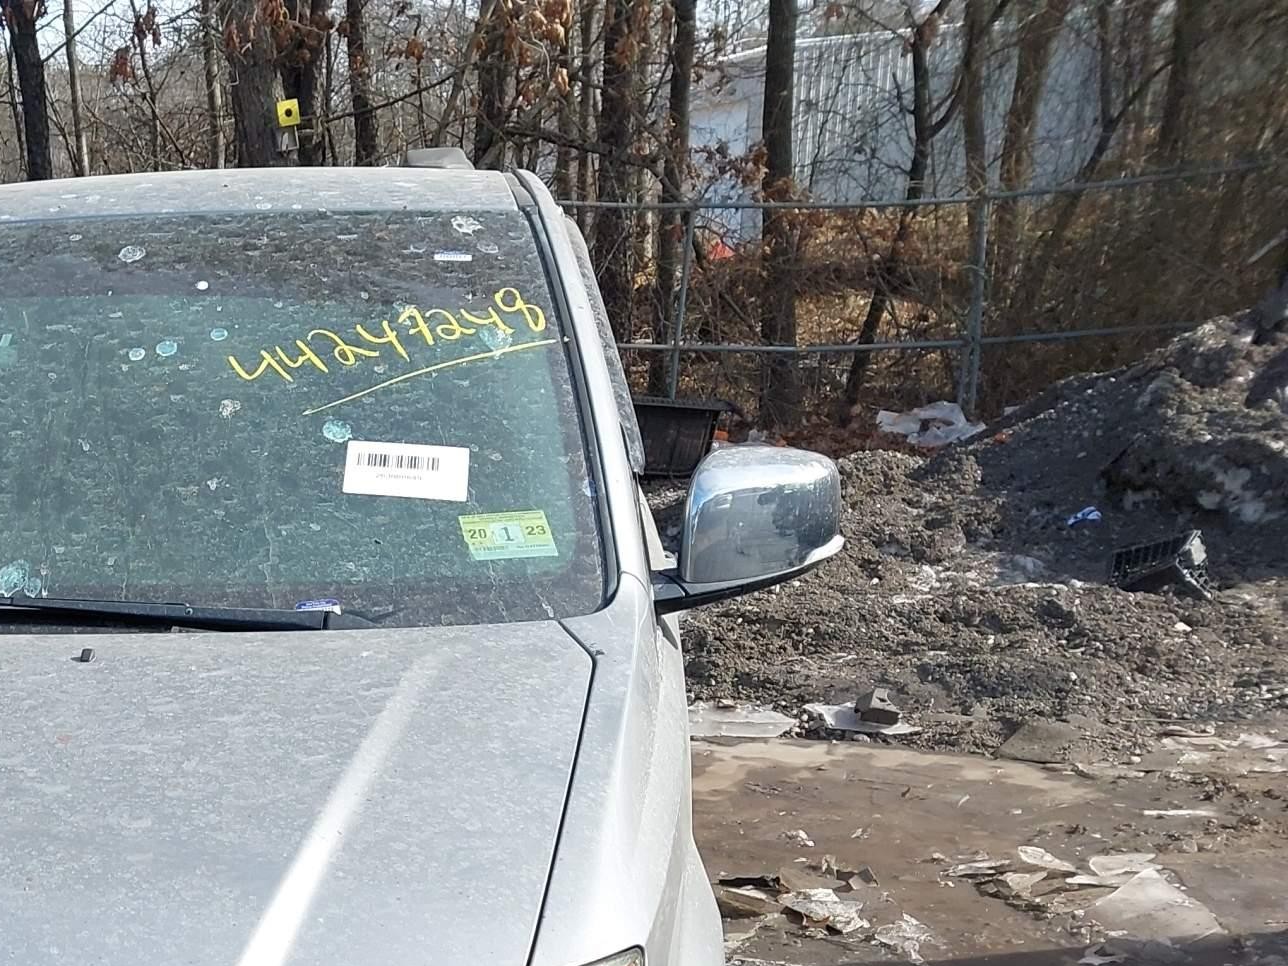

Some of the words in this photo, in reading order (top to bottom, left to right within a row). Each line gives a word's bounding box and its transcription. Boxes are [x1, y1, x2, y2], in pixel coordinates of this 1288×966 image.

[228, 287, 547, 383] 44247248
[468, 528, 488, 540] 20
[501, 526, 514, 542] 1
[525, 524, 546, 536] 23
